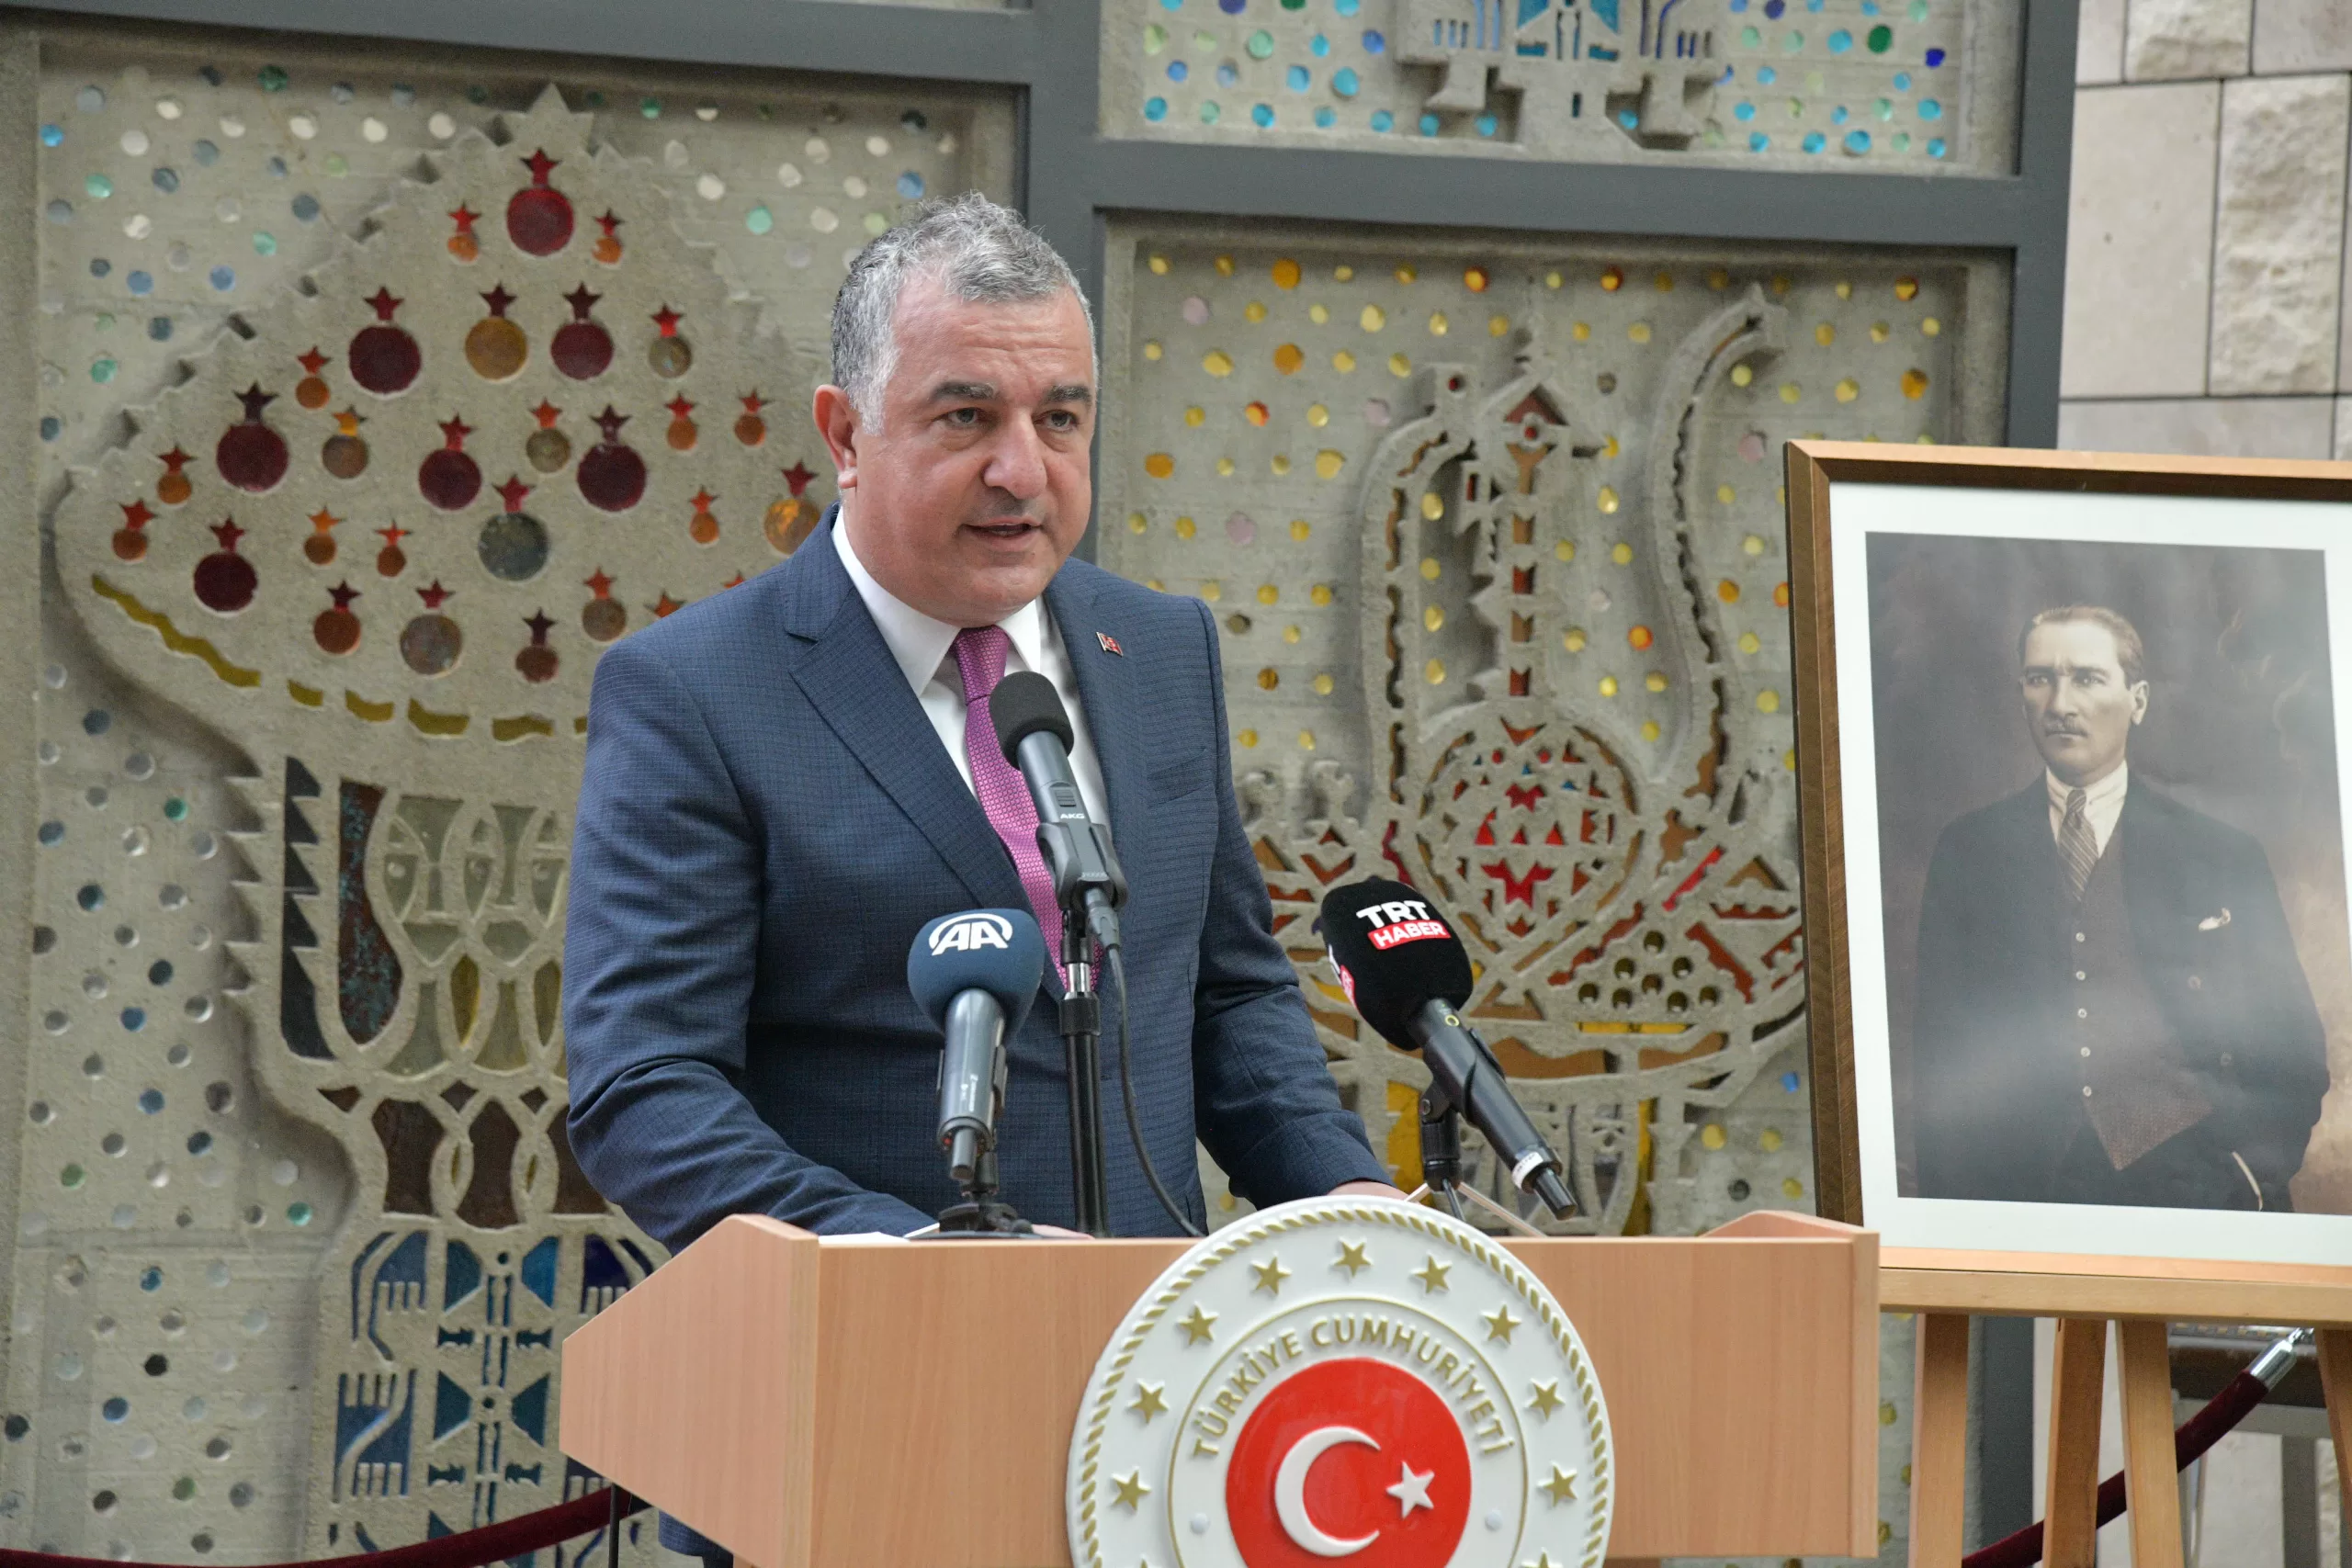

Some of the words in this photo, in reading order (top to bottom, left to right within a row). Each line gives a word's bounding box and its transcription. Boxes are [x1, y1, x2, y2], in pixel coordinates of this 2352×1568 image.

[1355, 900, 1430, 929] TRT
[931, 920, 1009, 956] AA
[1373, 922, 1447, 947] HABER
[1193, 1329, 1304, 1457] TÜRKİYE
[1310, 1313, 1515, 1455] CUMHURİYETİ
